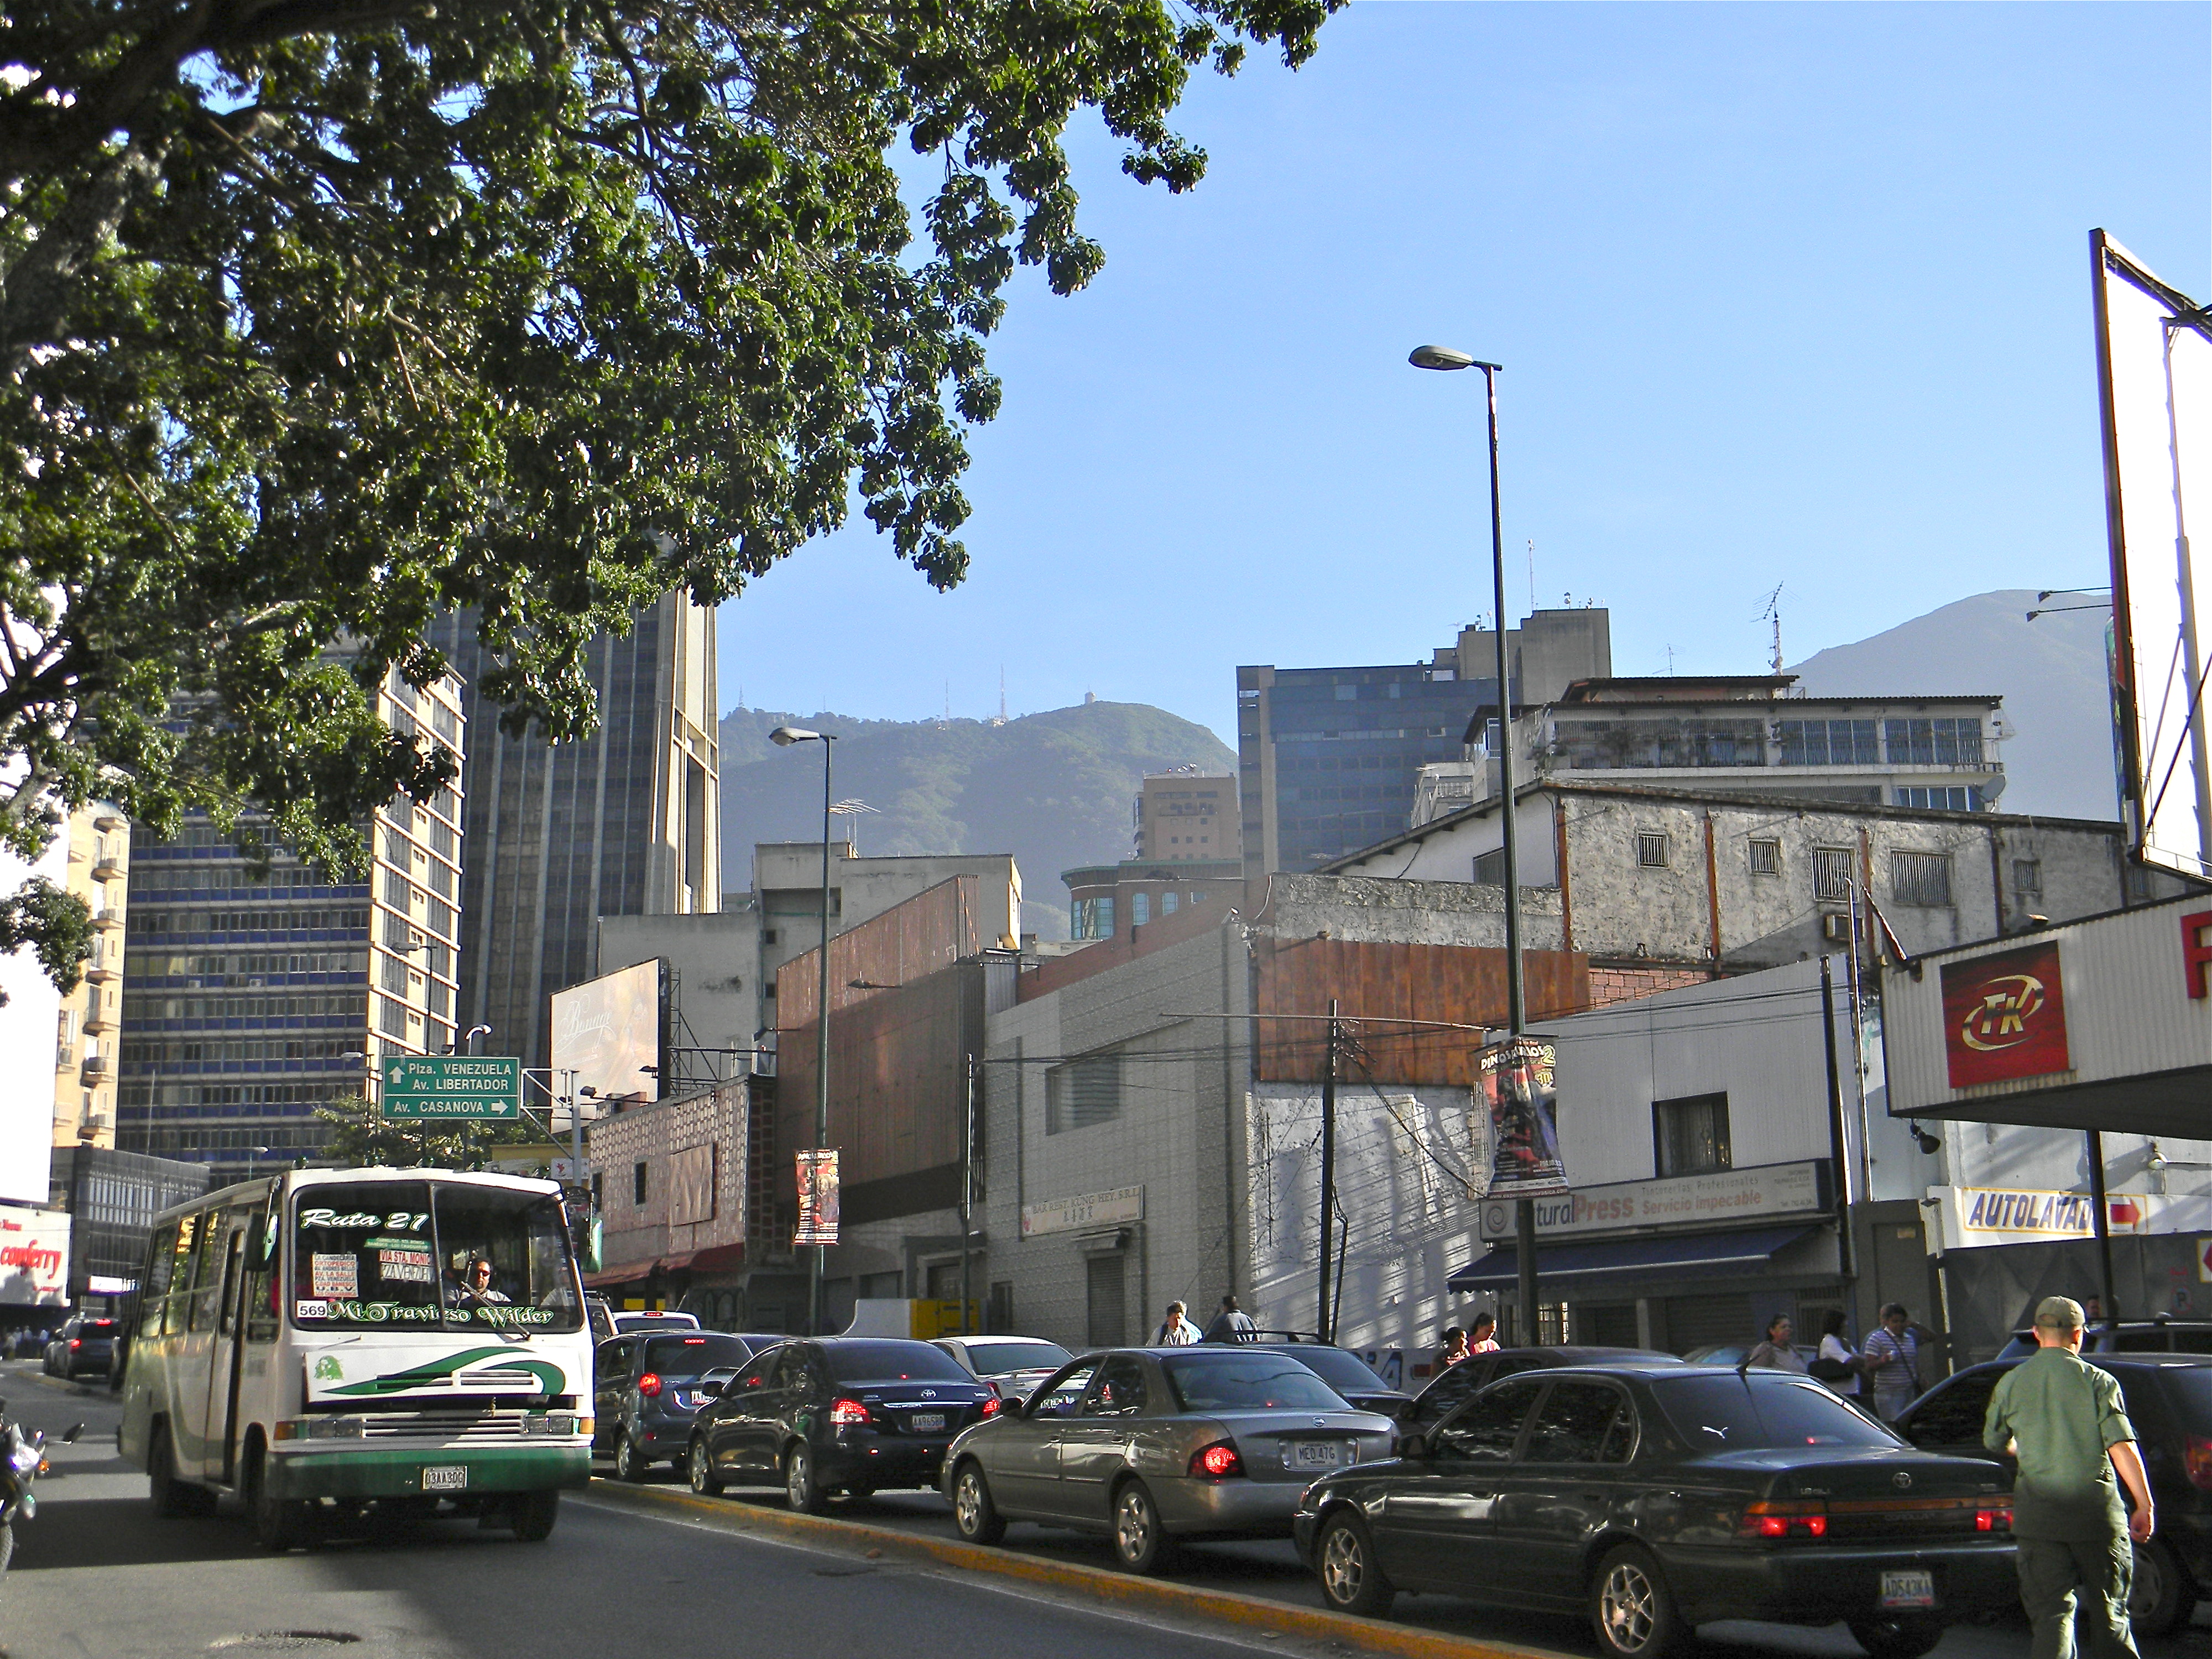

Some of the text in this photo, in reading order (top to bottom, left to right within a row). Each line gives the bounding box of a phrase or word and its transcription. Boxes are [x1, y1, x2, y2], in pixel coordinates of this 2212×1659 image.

[1541, 1045, 1556, 1067] 2
[409, 1063, 512, 1075] Plza. VENEZUELA
[413, 1079, 508, 1090] Av. LIBERTADOR
[1537, 1072, 1552, 1085] 3D
[394, 1101, 484, 1112] Av. CASANOVA
[1071, 1195, 1094, 1207] KUNG
[1642, 1197, 1692, 1214] Servicio
[1969, 1193, 2094, 1230] AUTOLAVAD
[300, 1208, 429, 1231] Ruta 21
[380, 1250, 392, 1261] VIA
[394, 1251, 408, 1262] STA.
[300, 1306, 326, 1316] 569
[327, 1301, 363, 1321] Mi
[476, 1307, 554, 1328] Wilder
